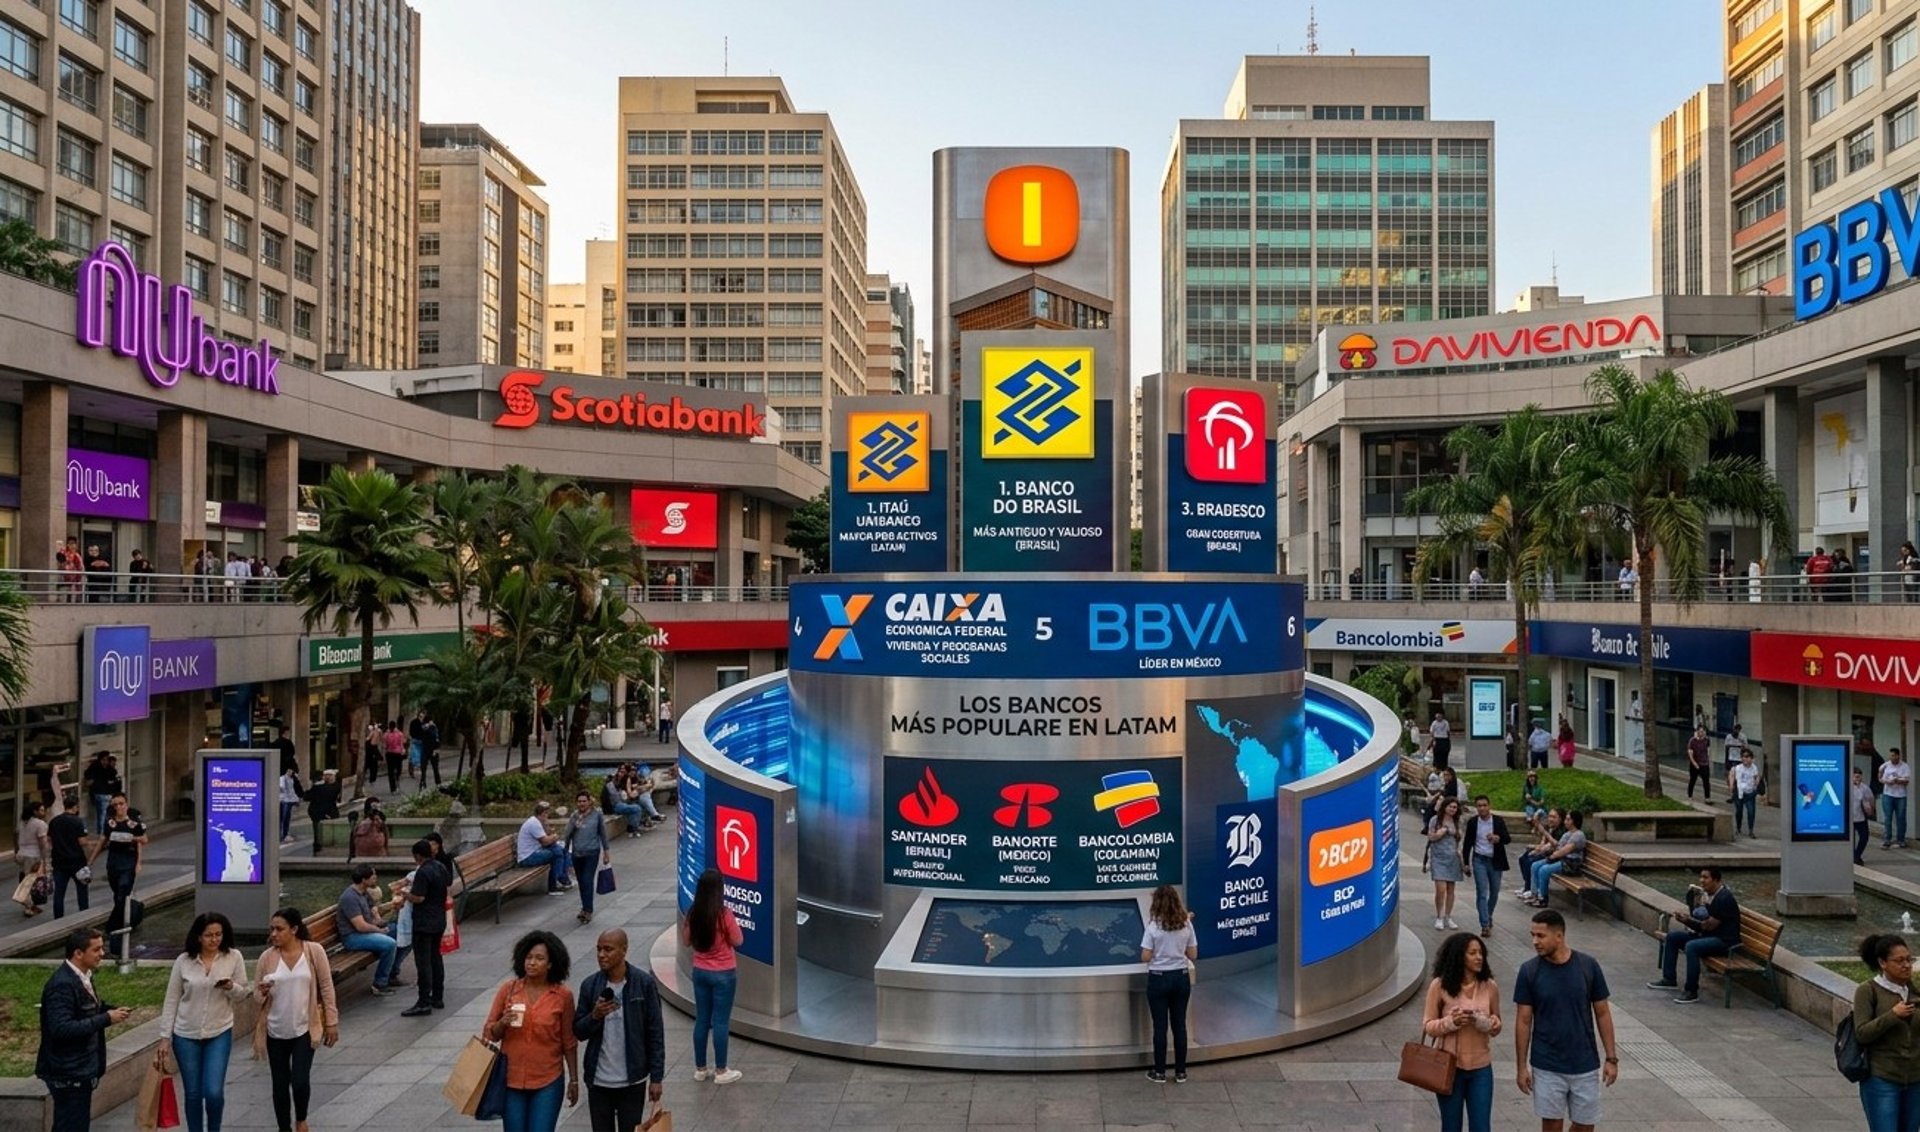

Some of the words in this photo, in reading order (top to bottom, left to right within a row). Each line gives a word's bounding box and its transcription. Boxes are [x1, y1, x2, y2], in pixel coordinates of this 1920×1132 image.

[1392, 314, 1661, 365] DAVIVIENDA
[551, 385, 766, 438] Scotiabank
[1015, 481, 1075, 496] BANCO
[993, 499, 1018, 514] DO
[1022, 499, 1082, 514] BRASIL
[1181, 502, 1194, 516] 3.
[1048, 527, 1055, 537] Y
[885, 593, 1007, 622] CAIXA
[954, 625, 1007, 637] FEDERAL
[1035, 617, 1054, 640] 5
[1089, 597, 1248, 651] BBVA
[1286, 615, 1296, 638] 6
[932, 641, 940, 651] Y
[1336, 630, 1444, 648] Bancolombia
[152, 655, 199, 680] BANK
[1139, 656, 1169, 669] LÍDER
[1170, 658, 1184, 669] EN
[1185, 656, 1222, 668] MÉXICO
[959, 695, 1001, 714] LOS
[1008, 696, 1102, 714] BANCOS
[891, 711, 936, 734] MÁS
[942, 717, 1062, 736] POPULARE
[1068, 717, 1097, 736] EN
[1105, 716, 1177, 735] LATAM
[891, 829, 967, 846] SANTANDER
[992, 835, 1058, 848] BANORTE
[1079, 832, 1175, 847] BANCOLOMBIA
[1224, 876, 1265, 894] BANCO
[1220, 895, 1237, 910] DE
[1238, 890, 1269, 907] CHILE
